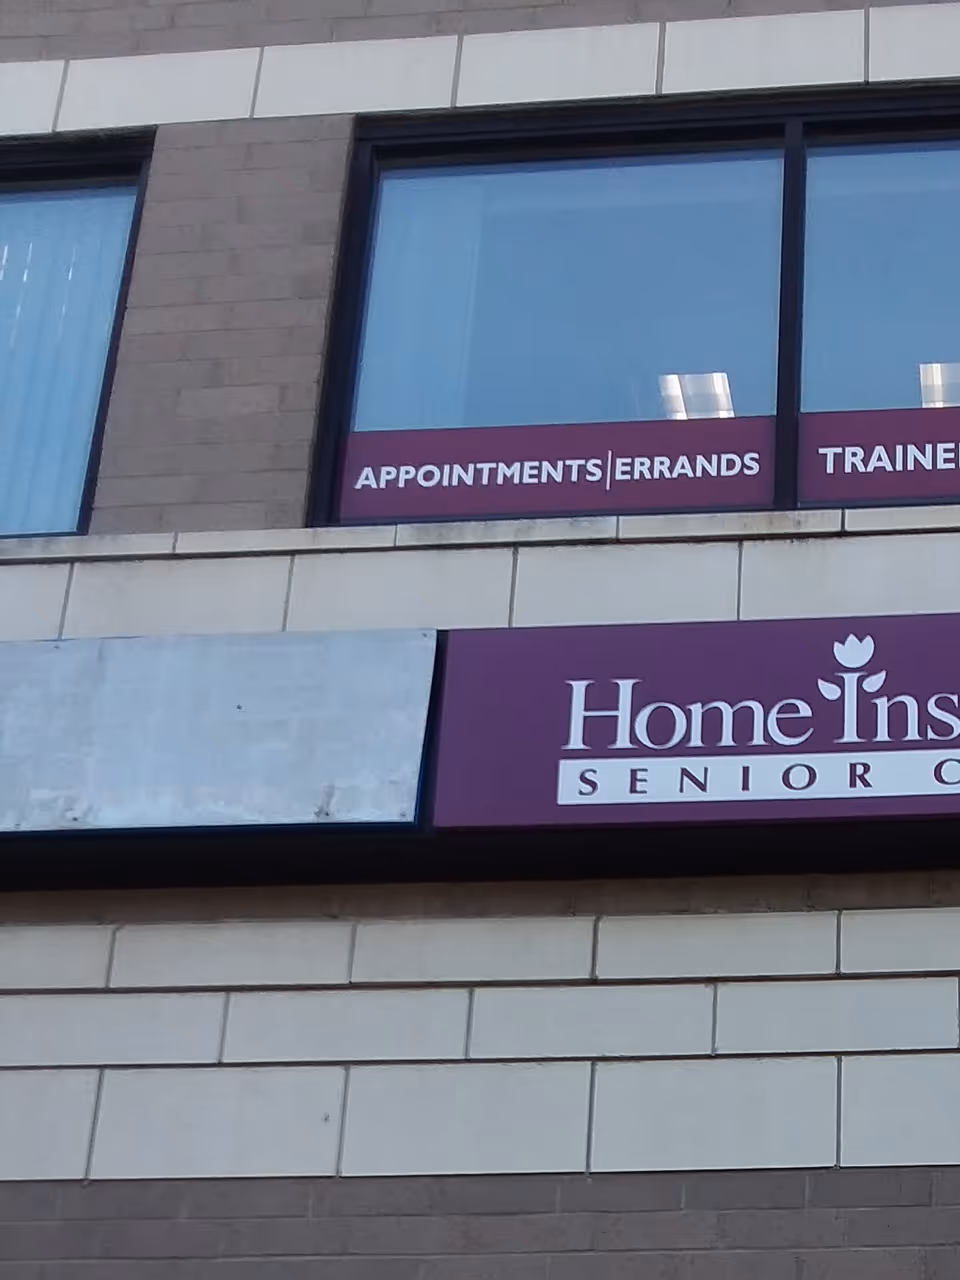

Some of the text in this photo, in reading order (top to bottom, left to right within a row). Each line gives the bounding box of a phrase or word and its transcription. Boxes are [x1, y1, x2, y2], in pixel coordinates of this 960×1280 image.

[354, 452, 760, 489] APPOINTMENTS ERRANDS
[561, 678, 814, 750] Home
[578, 762, 873, 796] SENIOR
